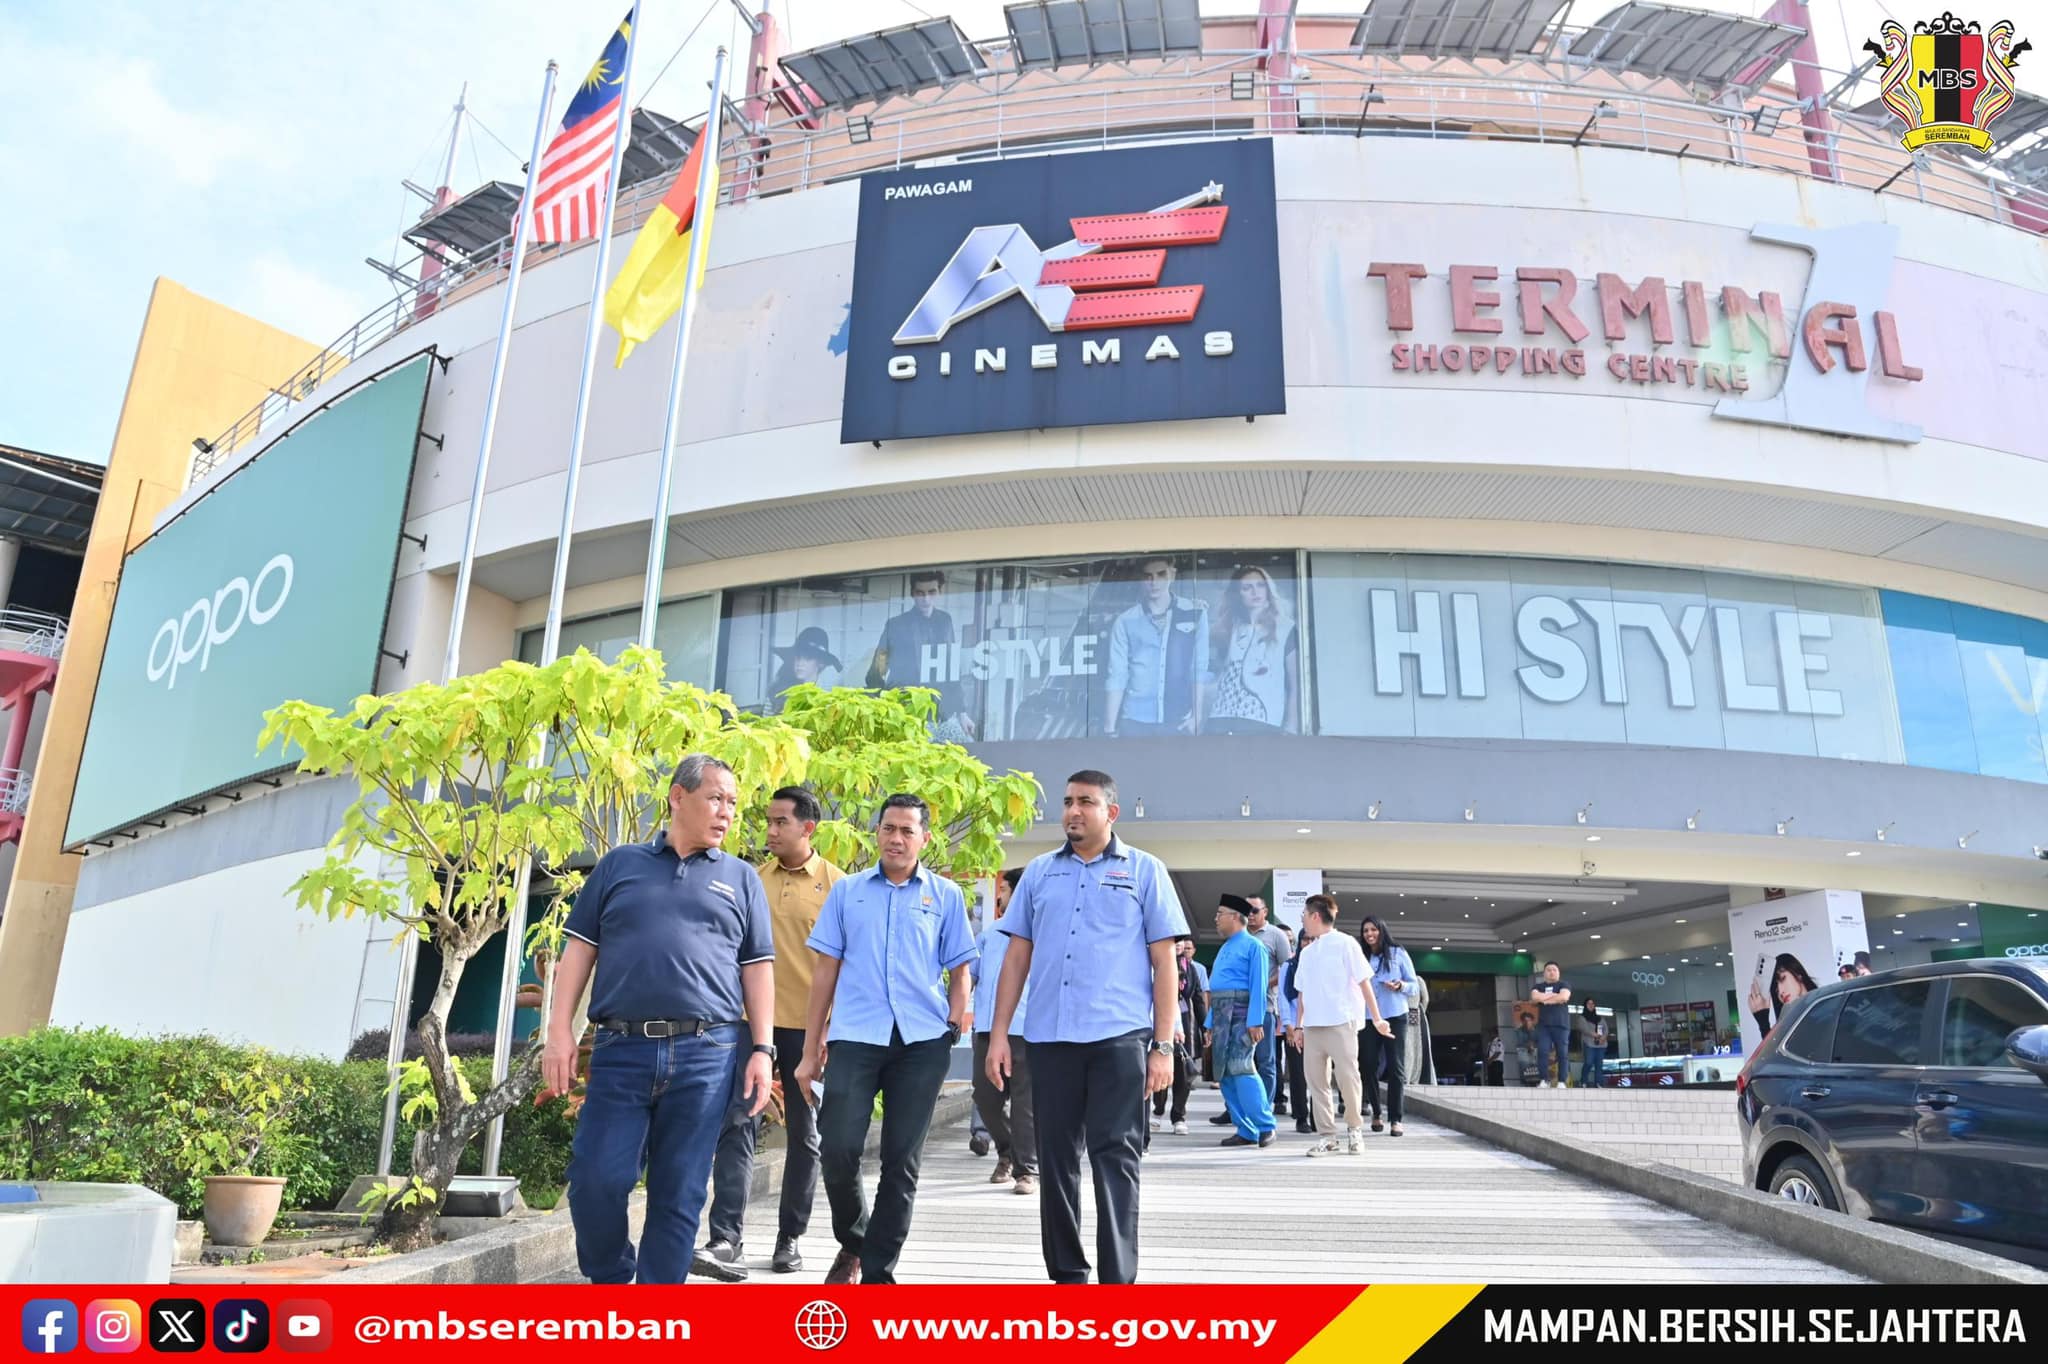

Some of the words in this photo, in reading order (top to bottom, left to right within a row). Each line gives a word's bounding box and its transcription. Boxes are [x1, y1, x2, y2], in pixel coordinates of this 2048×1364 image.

[884, 179, 973, 200] PAWAGAM
[1366, 261, 1923, 382] TERMINAL
[887, 330, 1234, 379] CINEMAS
[1391, 343, 1587, 376] SHOPPING
[1607, 353, 1749, 392] CENTRE
[147, 554, 293, 690] oppo
[919, 643, 962, 684] HI
[970, 635, 1098, 681] STYLE
[1368, 588, 1487, 700] HI
[1514, 594, 1843, 717] STYLE
